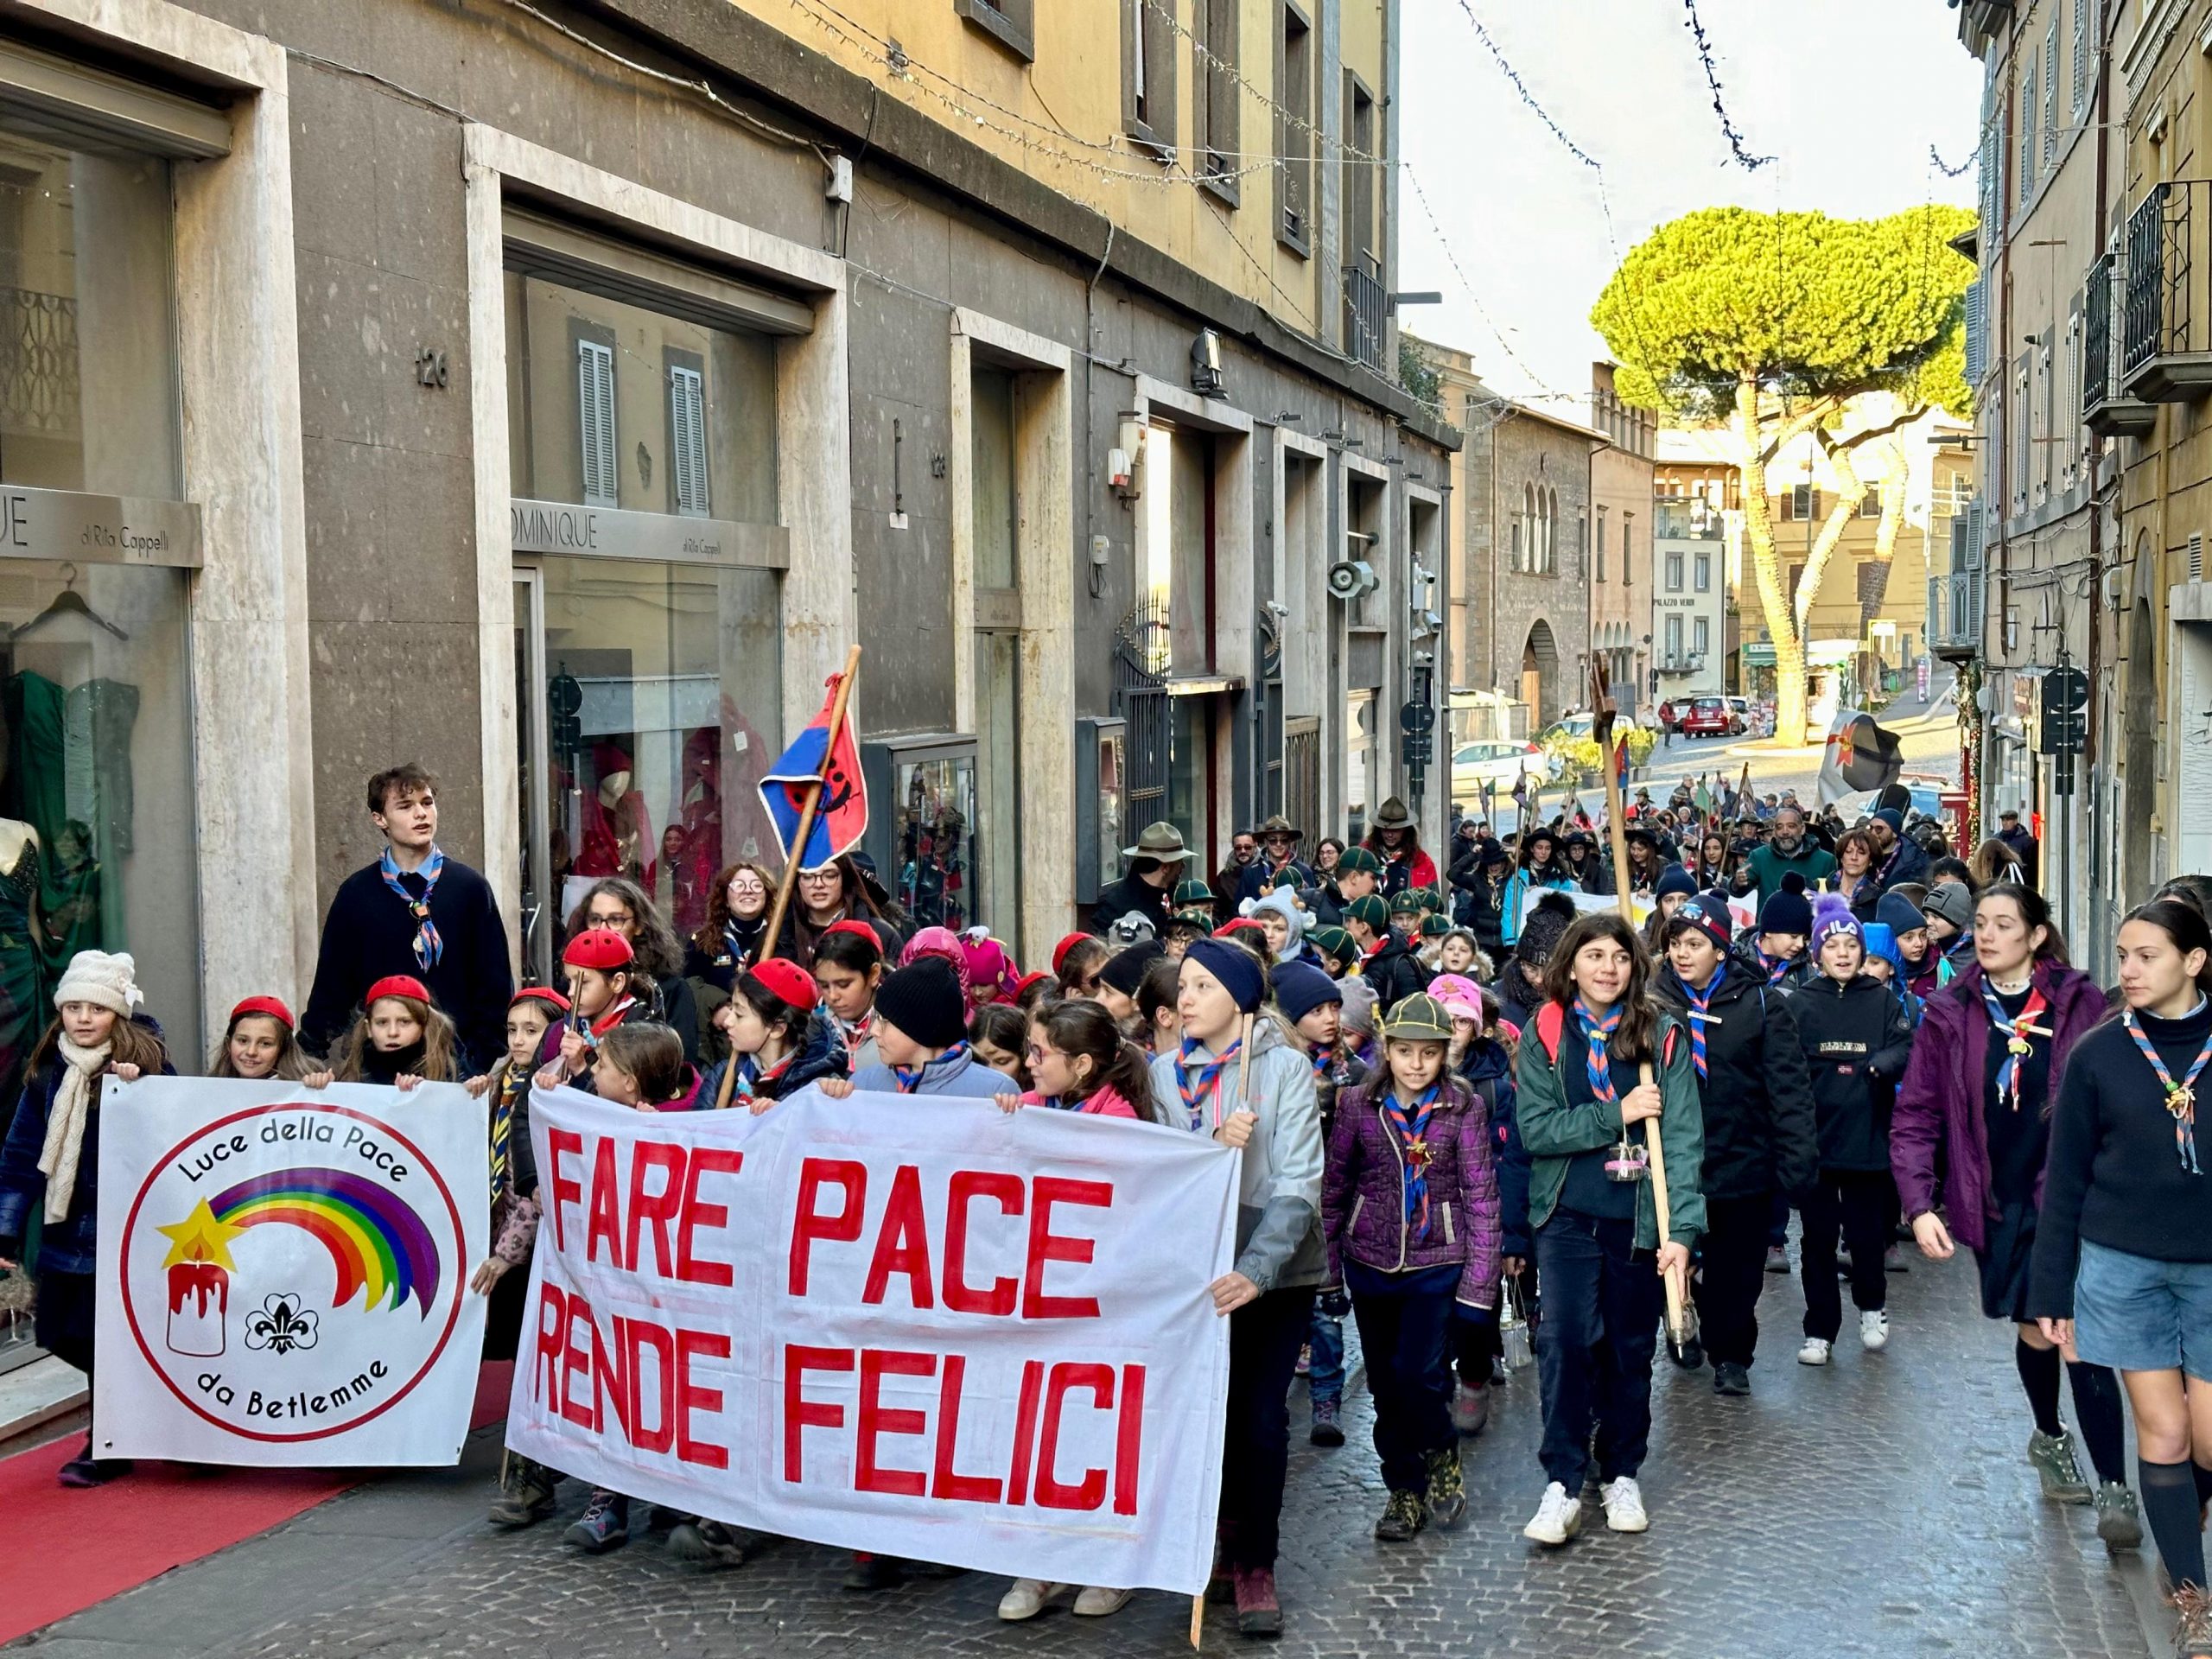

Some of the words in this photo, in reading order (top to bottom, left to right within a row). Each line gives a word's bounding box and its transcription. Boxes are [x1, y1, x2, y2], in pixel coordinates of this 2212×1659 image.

[119, 526, 169, 558] Cappelli
[1653, 598, 1678, 607] PALAZZO
[1820, 919, 1858, 942] FILA
[177, 1135, 249, 1183] Luce
[260, 1116, 334, 1145] della
[343, 1124, 409, 1183] Pace
[548, 1126, 743, 1287] FARE
[787, 1157, 1114, 1320] PACE
[197, 1371, 236, 1407] da
[246, 1358, 389, 1419] Betlemme
[534, 1280, 732, 1471] RENDE
[783, 1343, 1146, 1516] FELICI
